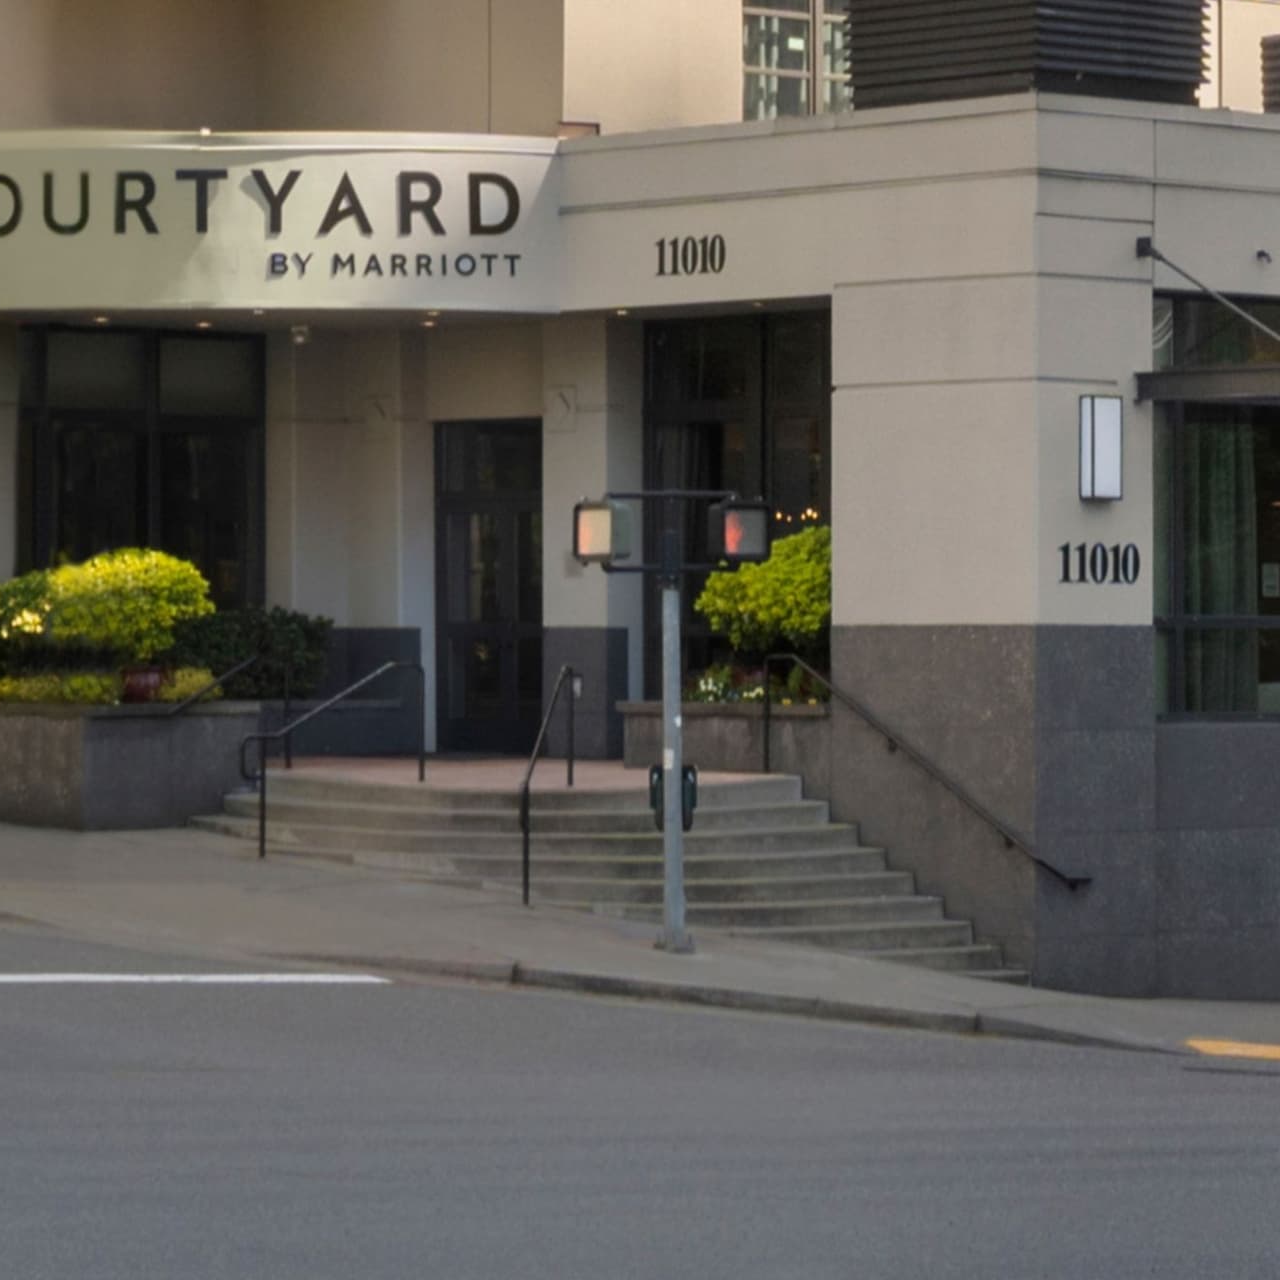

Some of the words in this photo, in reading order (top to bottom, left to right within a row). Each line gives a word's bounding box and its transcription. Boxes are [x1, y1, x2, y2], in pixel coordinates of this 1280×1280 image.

[269, 252, 312, 277] BY
[331, 252, 521, 277] MARRIOTT
[655, 234, 726, 277] 11010
[1058, 541, 1140, 584] 11010
